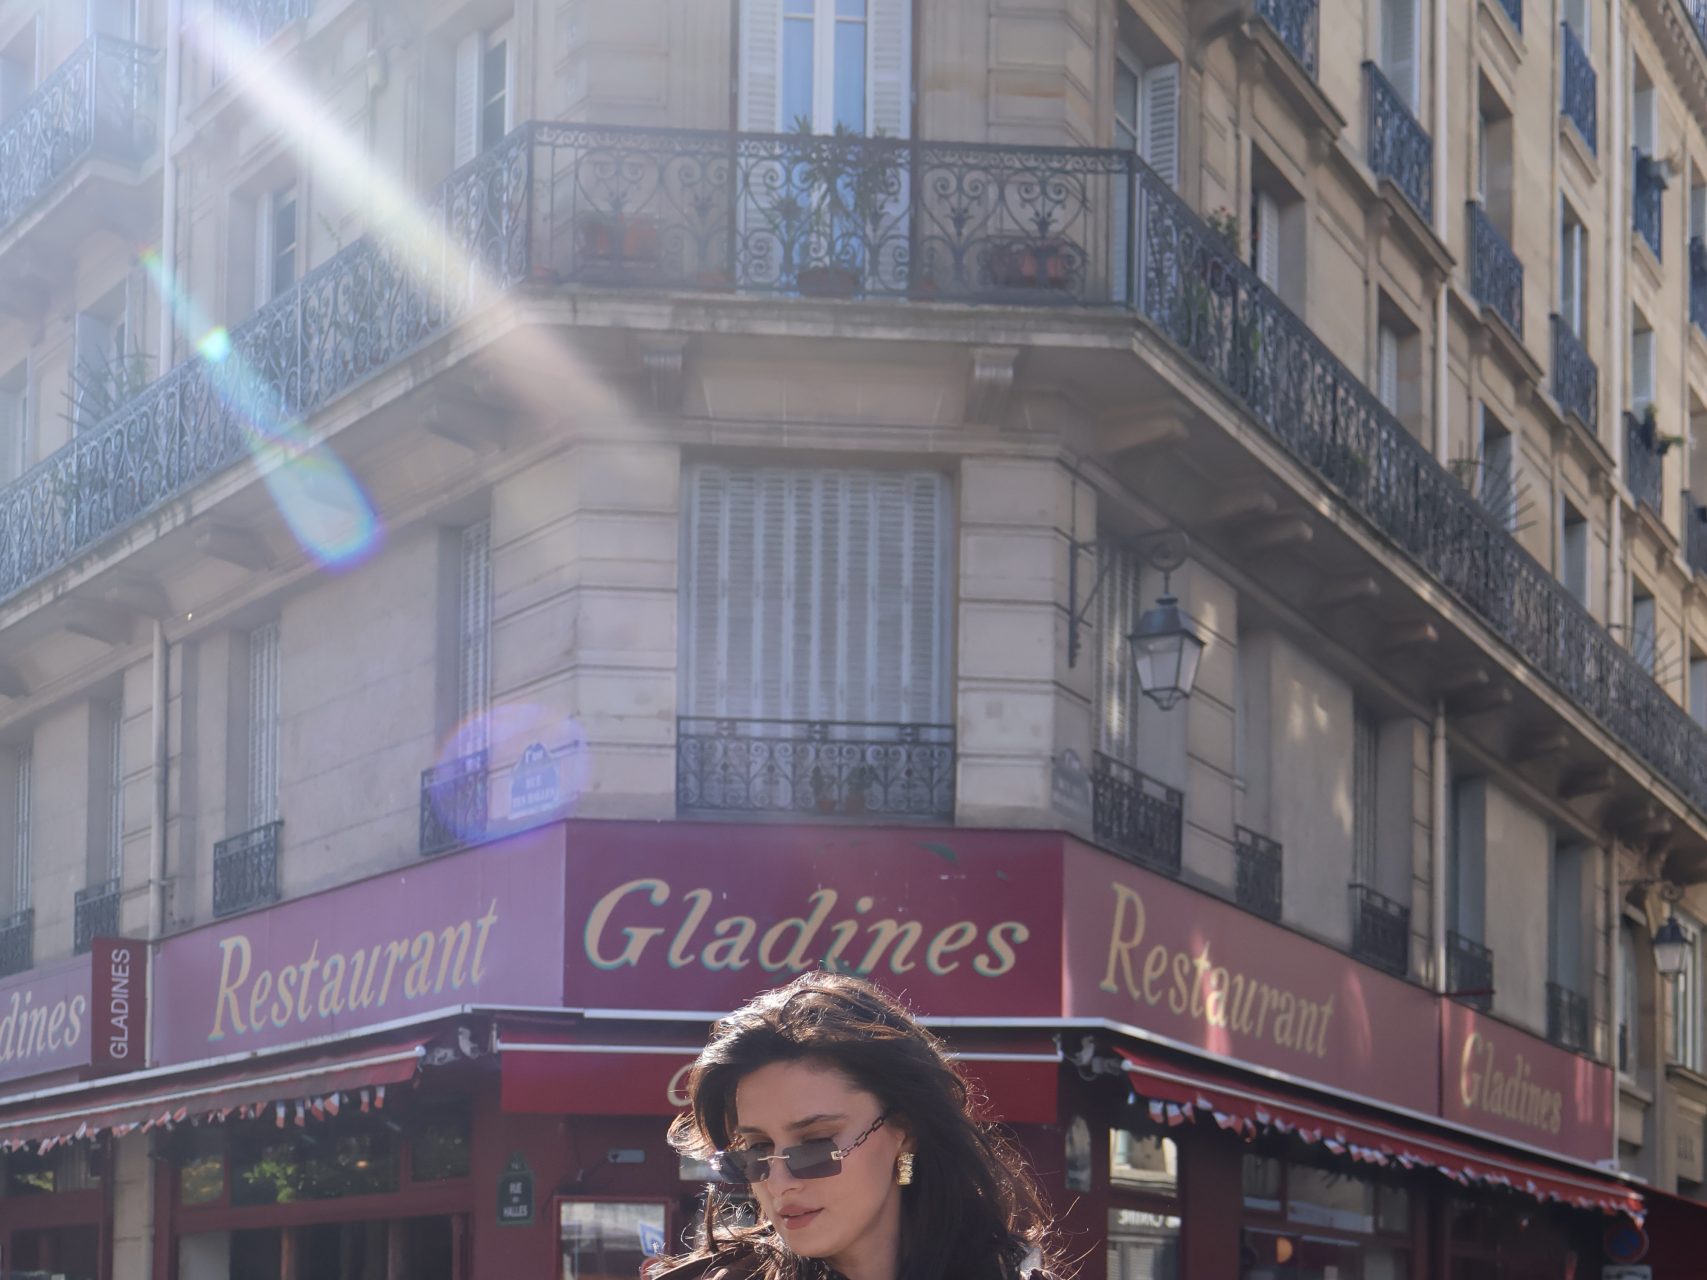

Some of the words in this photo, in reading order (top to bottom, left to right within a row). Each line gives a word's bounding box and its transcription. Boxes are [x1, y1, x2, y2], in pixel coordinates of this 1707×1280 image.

[207, 898, 498, 1042] Restaurant
[584, 878, 1029, 977] Gladines
[1100, 882, 1334, 1058] Restaurant
[109, 948, 131, 1060] GLADINES
[1461, 1032, 1562, 1136] Gladines
